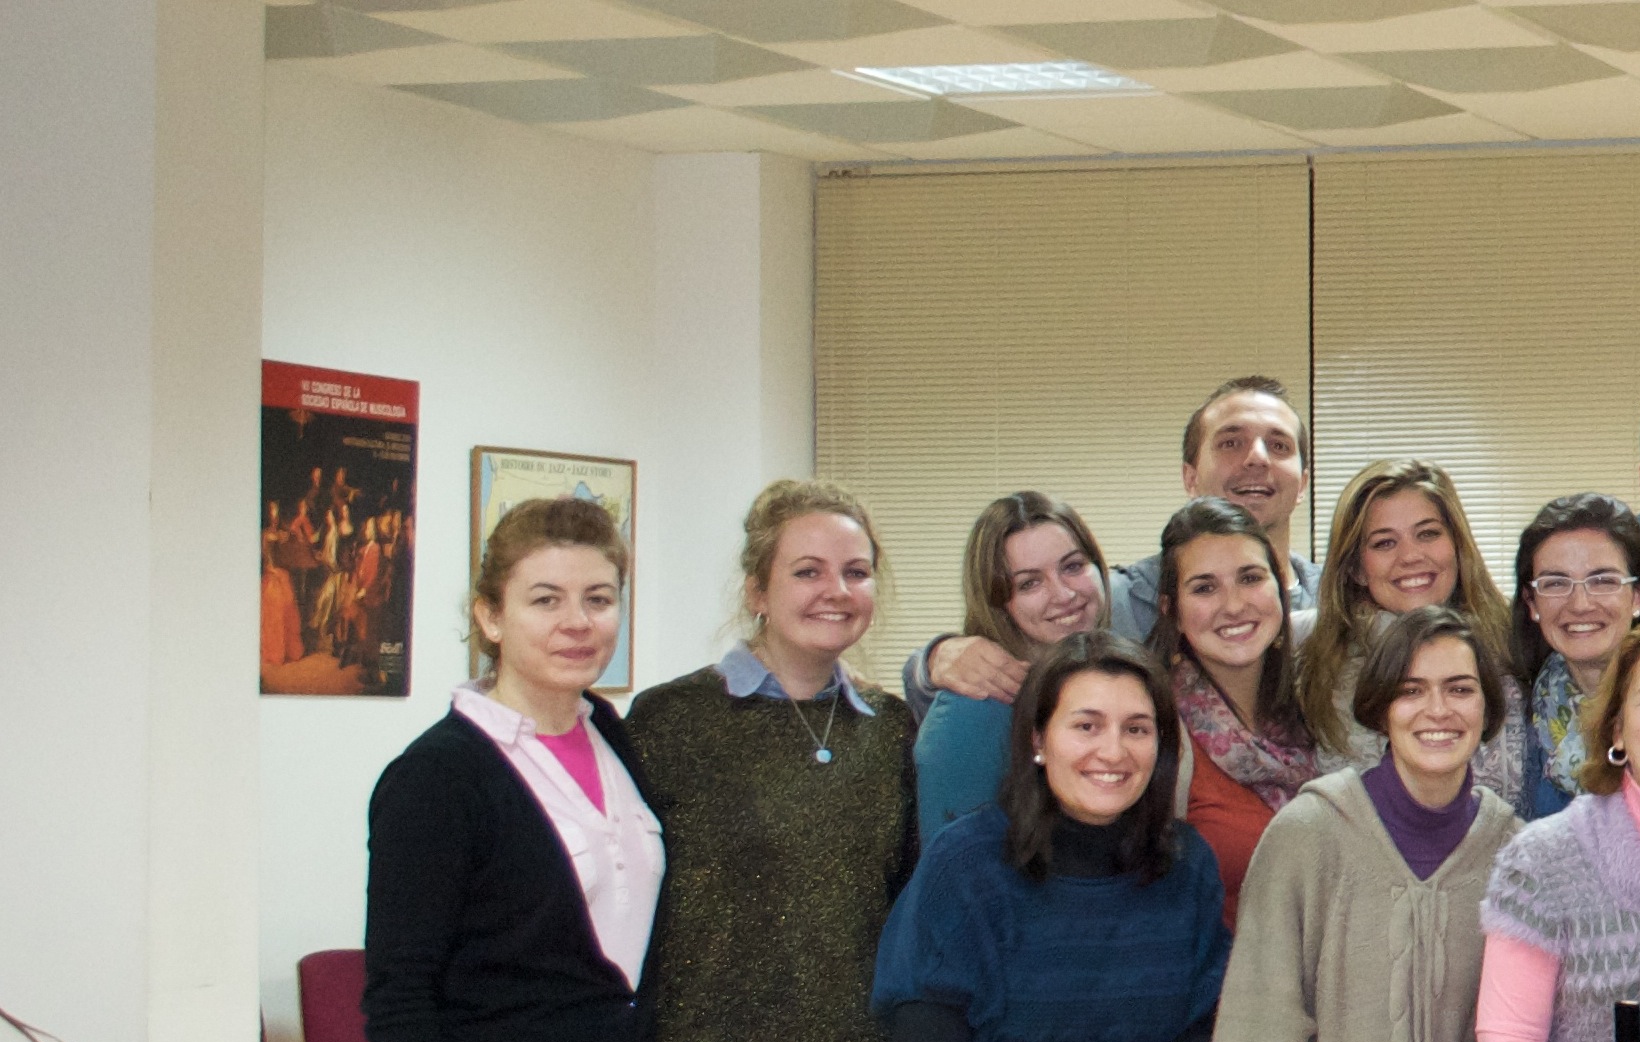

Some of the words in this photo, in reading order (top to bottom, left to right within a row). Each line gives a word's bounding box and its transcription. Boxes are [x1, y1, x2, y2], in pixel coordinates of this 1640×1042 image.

[312, 381, 341, 397] CONGRESO
[353, 387, 360, 399] LA
[548, 463, 566, 474] JAZZ
